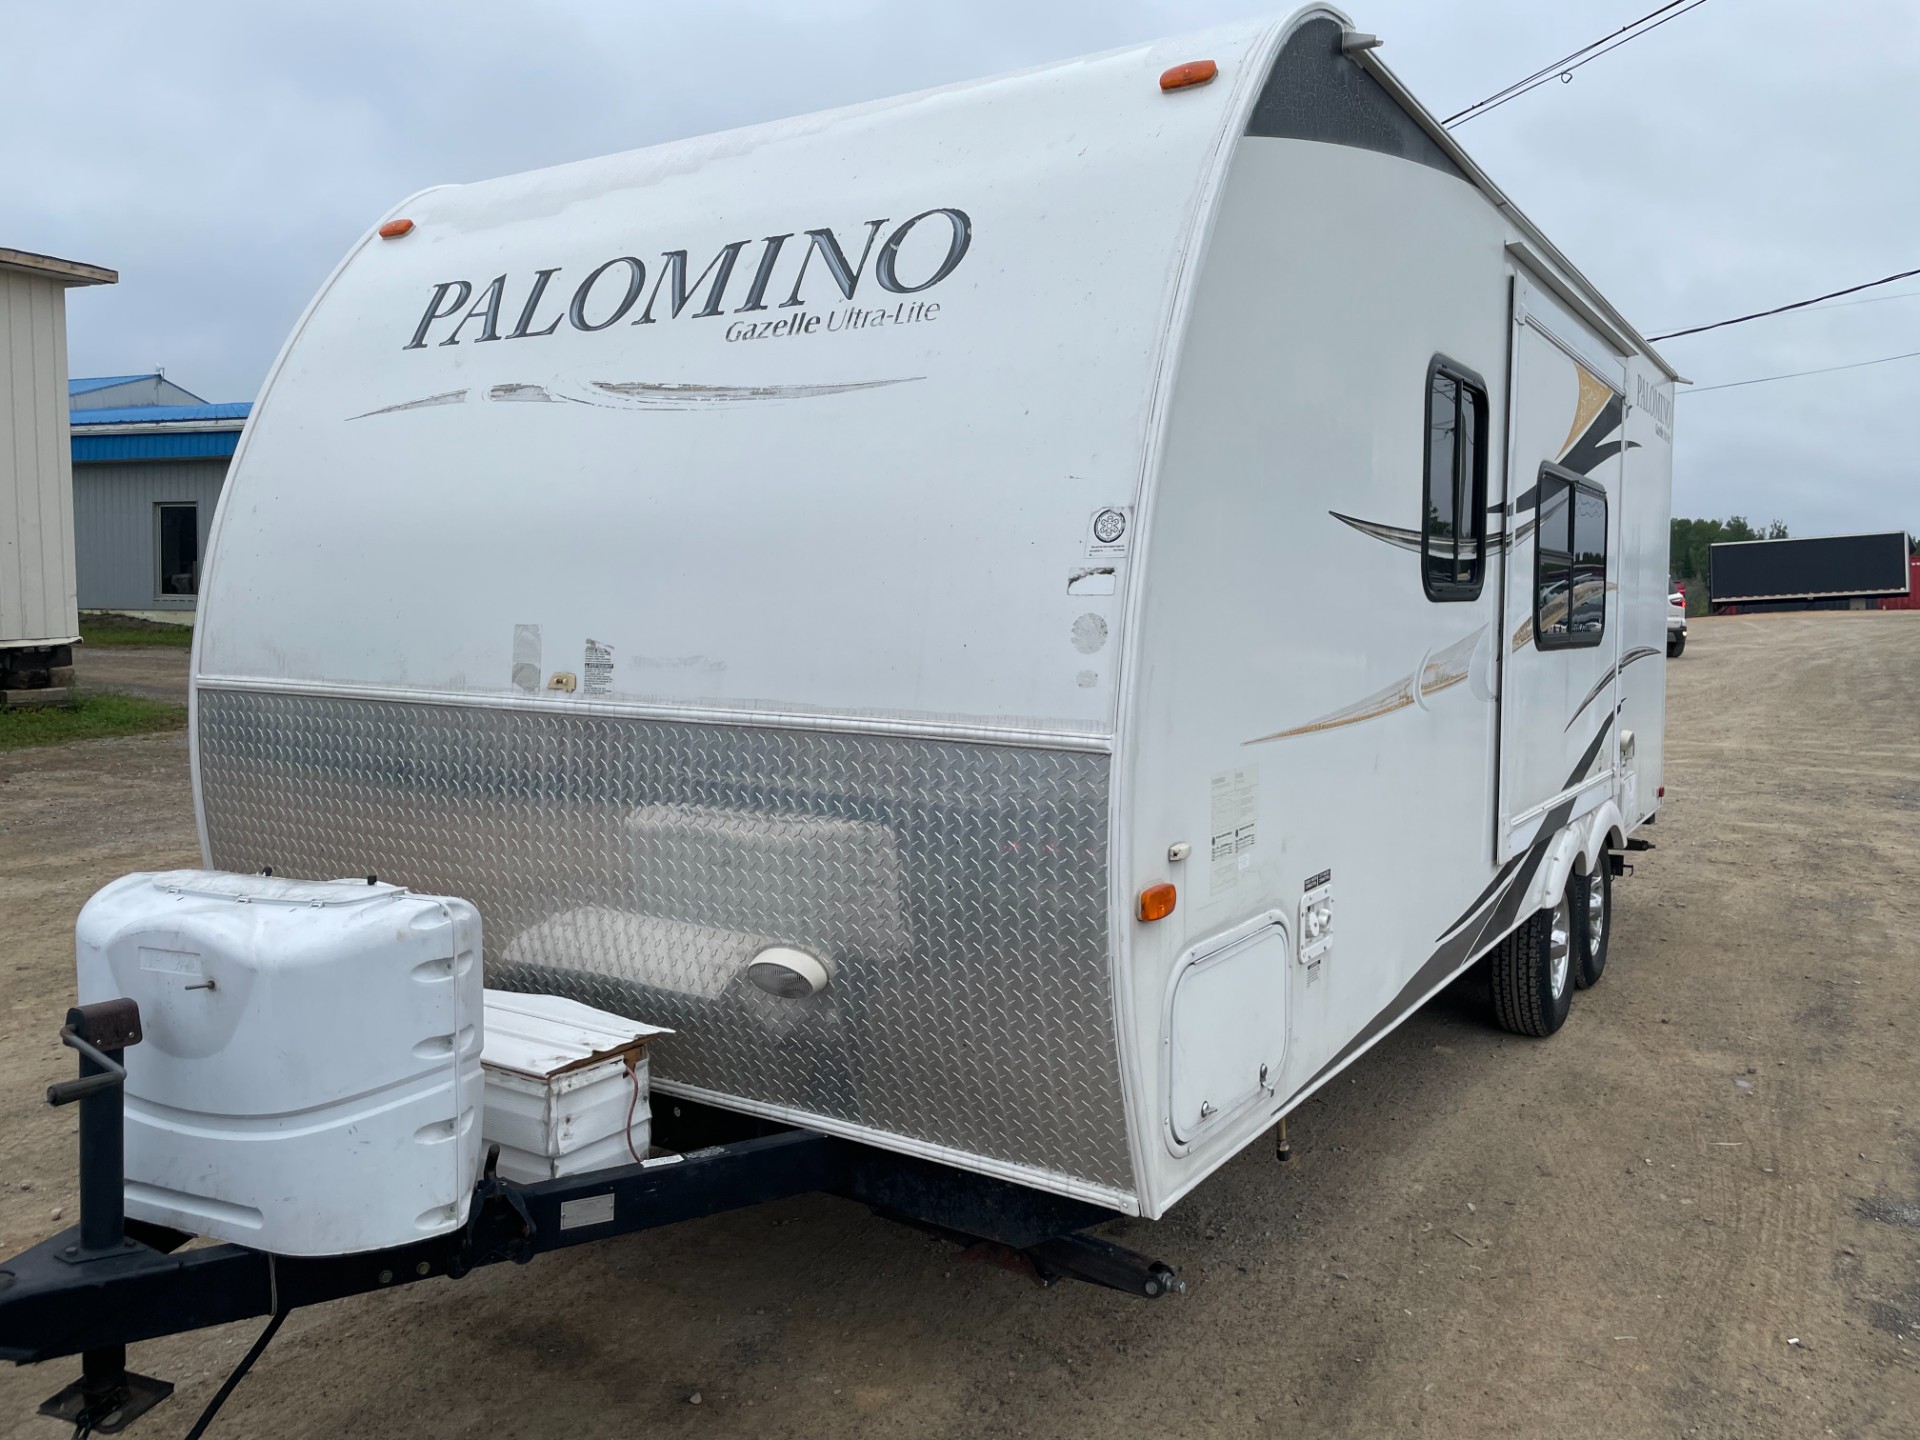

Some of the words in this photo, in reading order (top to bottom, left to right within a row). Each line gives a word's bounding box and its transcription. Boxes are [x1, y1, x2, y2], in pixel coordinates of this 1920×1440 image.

[402, 207, 972, 351] PALOMINO
[724, 311, 821, 343] Gazelle
[826, 300, 941, 332] Ultra-Lite
